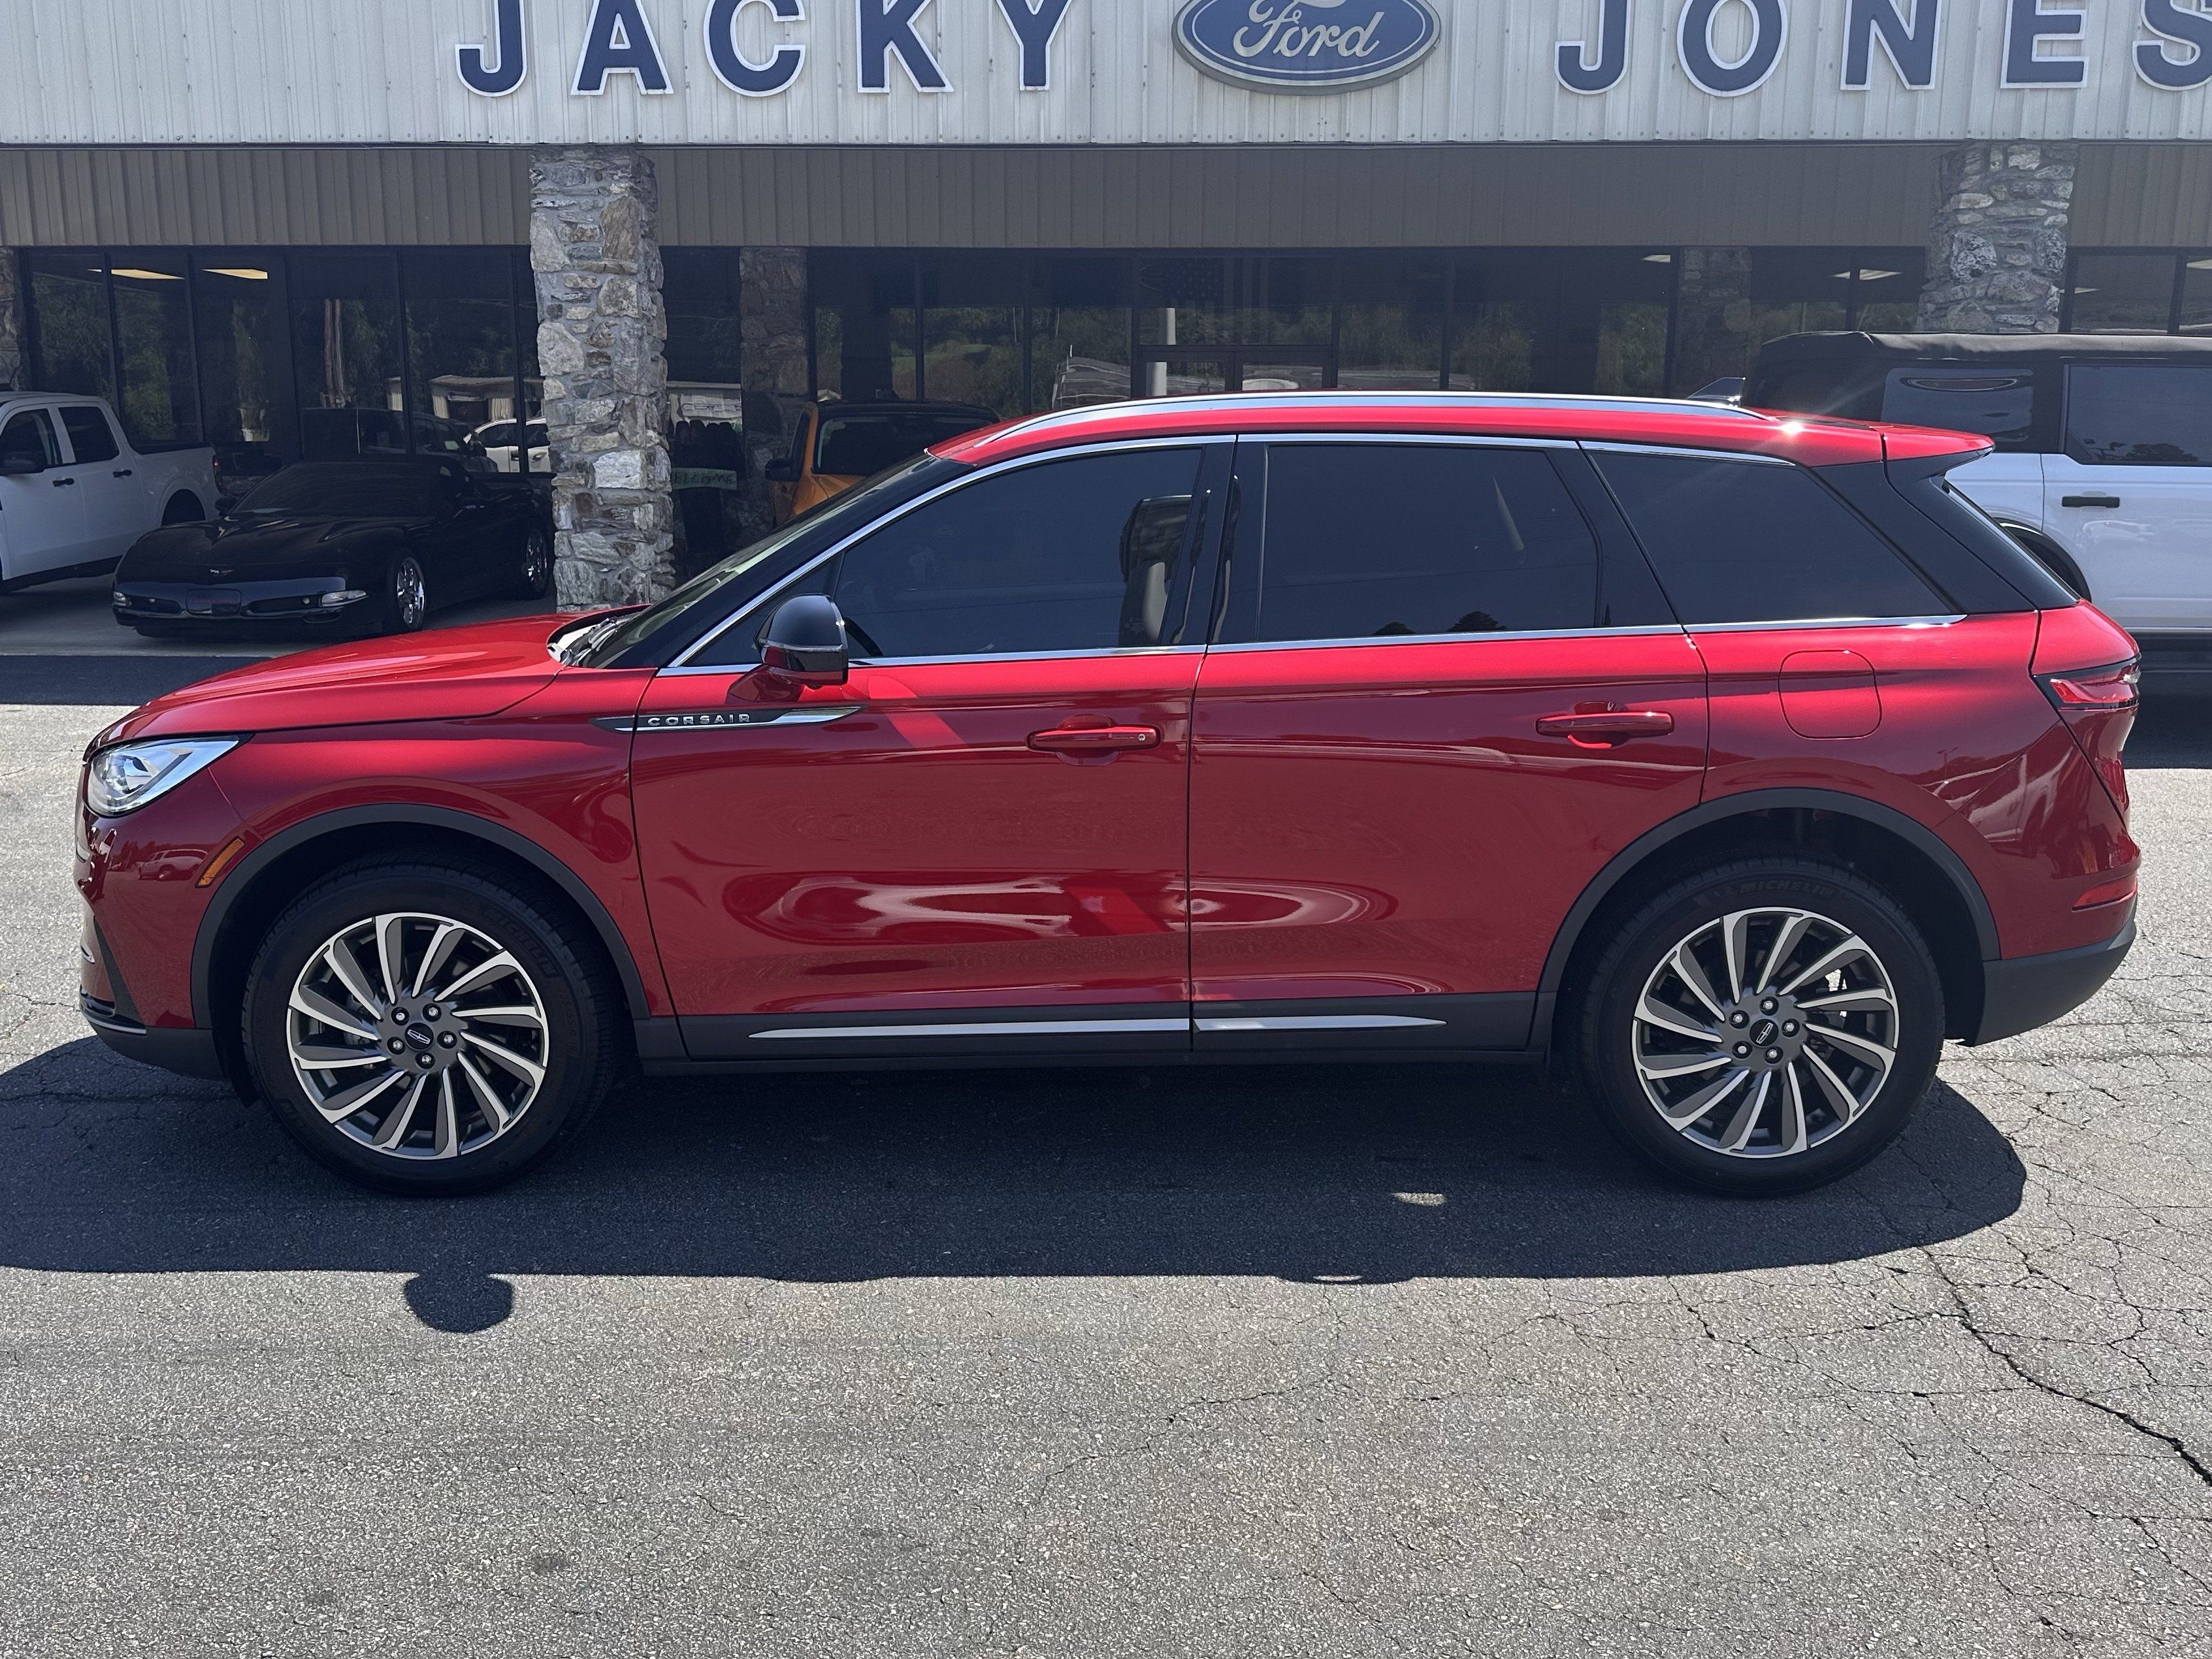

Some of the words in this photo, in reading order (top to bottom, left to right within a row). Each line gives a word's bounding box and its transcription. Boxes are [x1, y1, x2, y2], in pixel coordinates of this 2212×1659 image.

[1233, 0, 1384, 57] Ford
[455, 0, 1068, 97] JACKY
[673, 472, 732, 487] ELCOME
[648, 713, 751, 726] CORSAIR
